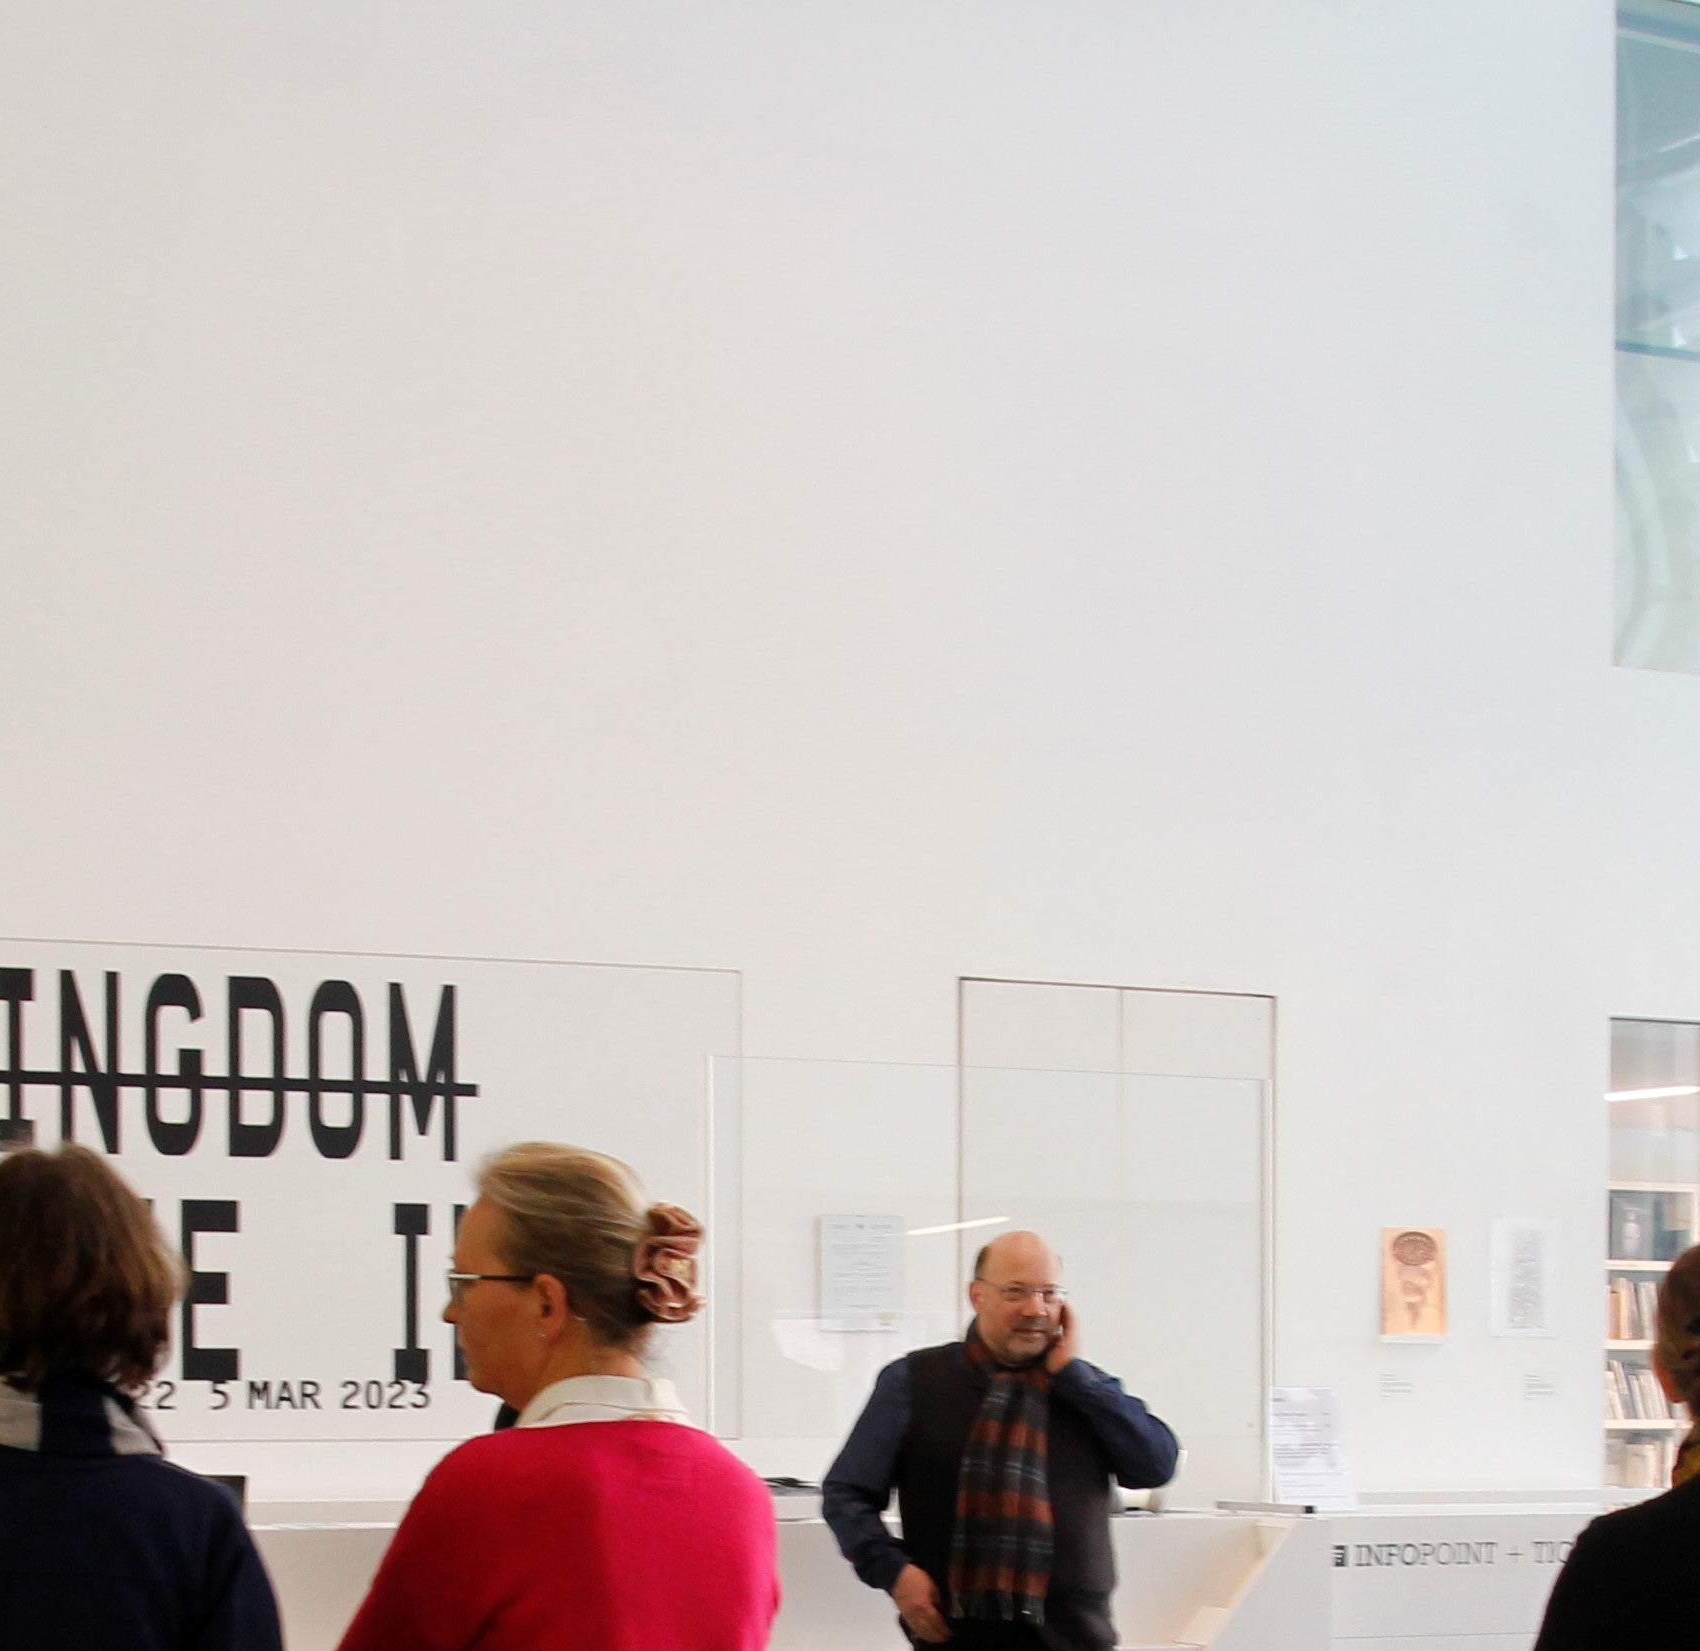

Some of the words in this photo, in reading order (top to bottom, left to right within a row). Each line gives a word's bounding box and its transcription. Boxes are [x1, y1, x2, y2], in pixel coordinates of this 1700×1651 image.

[210, 1379, 229, 1410] 5
[248, 1380, 324, 1411] MAR
[341, 1380, 431, 1410] 2023
[1355, 1541, 1499, 1567] INFOPOINT
